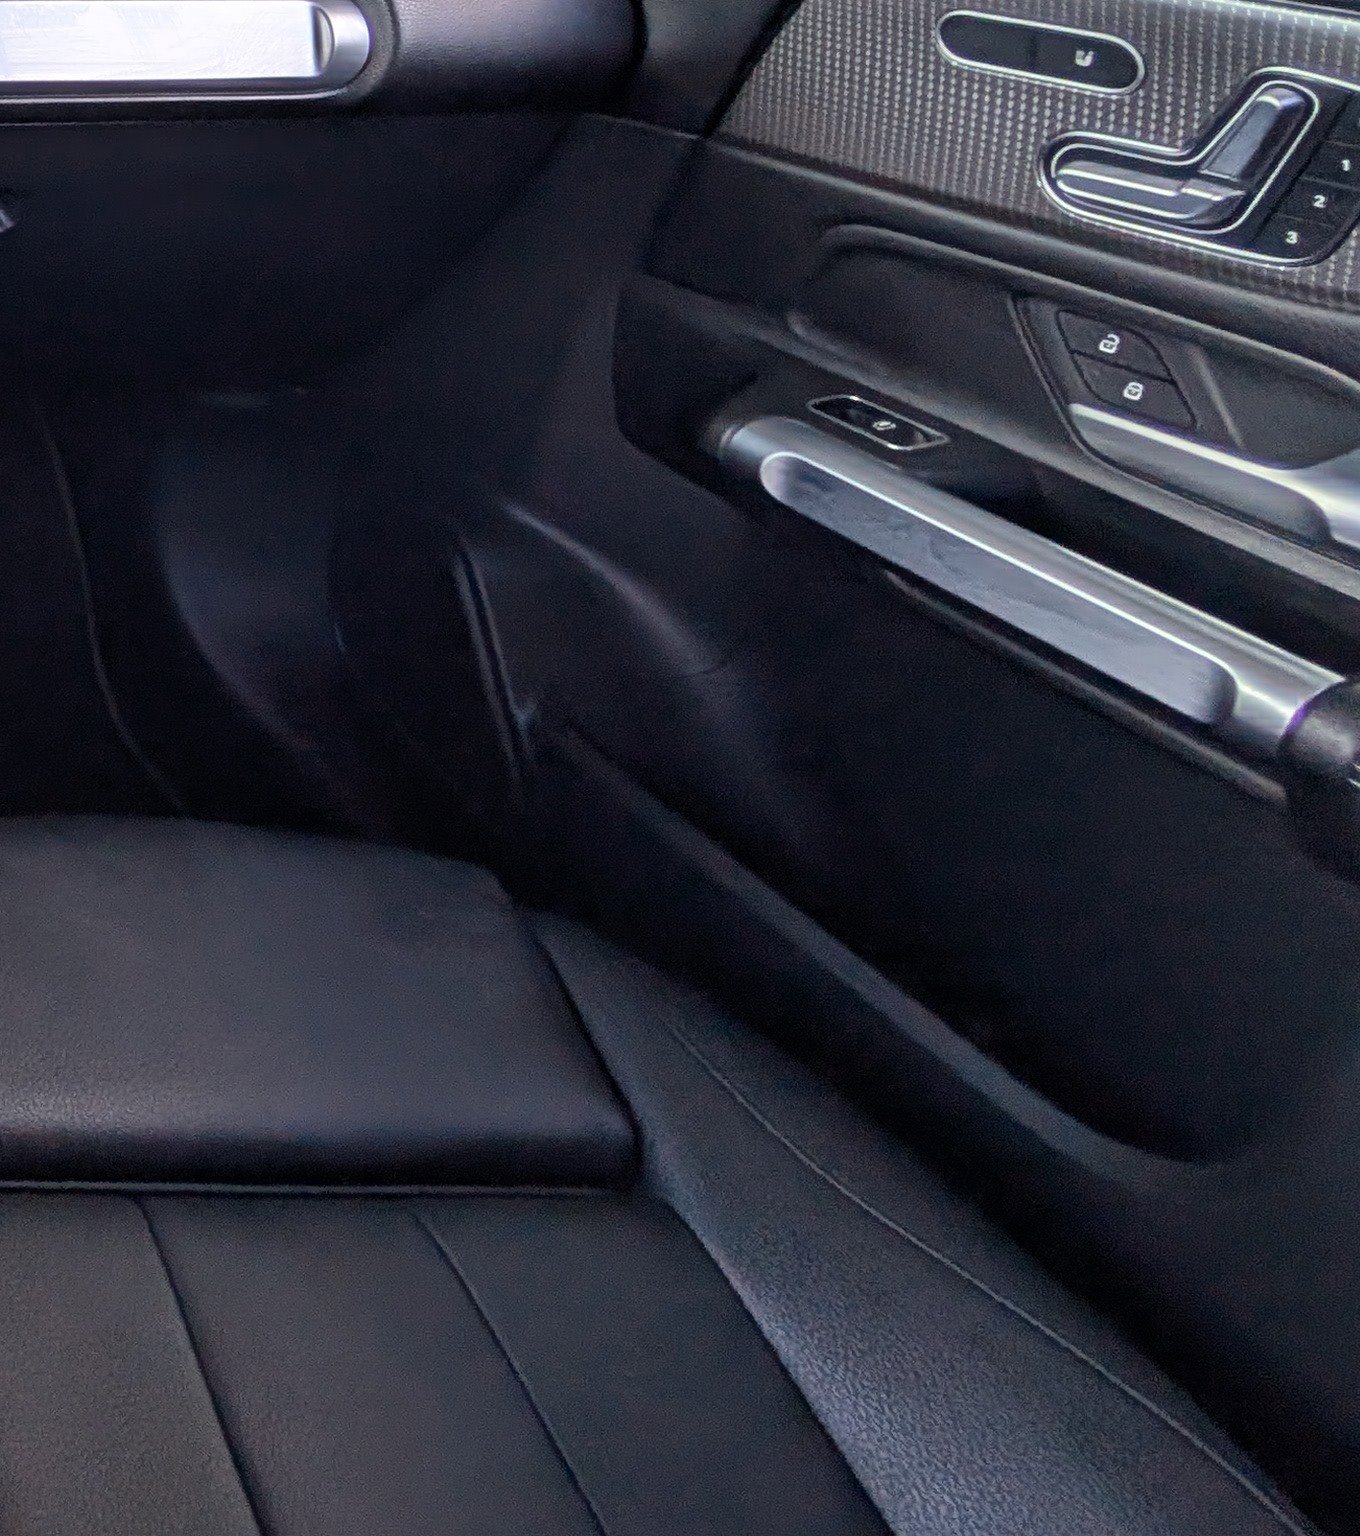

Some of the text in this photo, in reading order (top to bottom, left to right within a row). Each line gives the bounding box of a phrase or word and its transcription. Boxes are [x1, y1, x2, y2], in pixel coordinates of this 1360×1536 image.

[1342, 159, 1351, 172] 1
[1313, 194, 1326, 208] 2
[1285, 230, 1299, 244] 3
